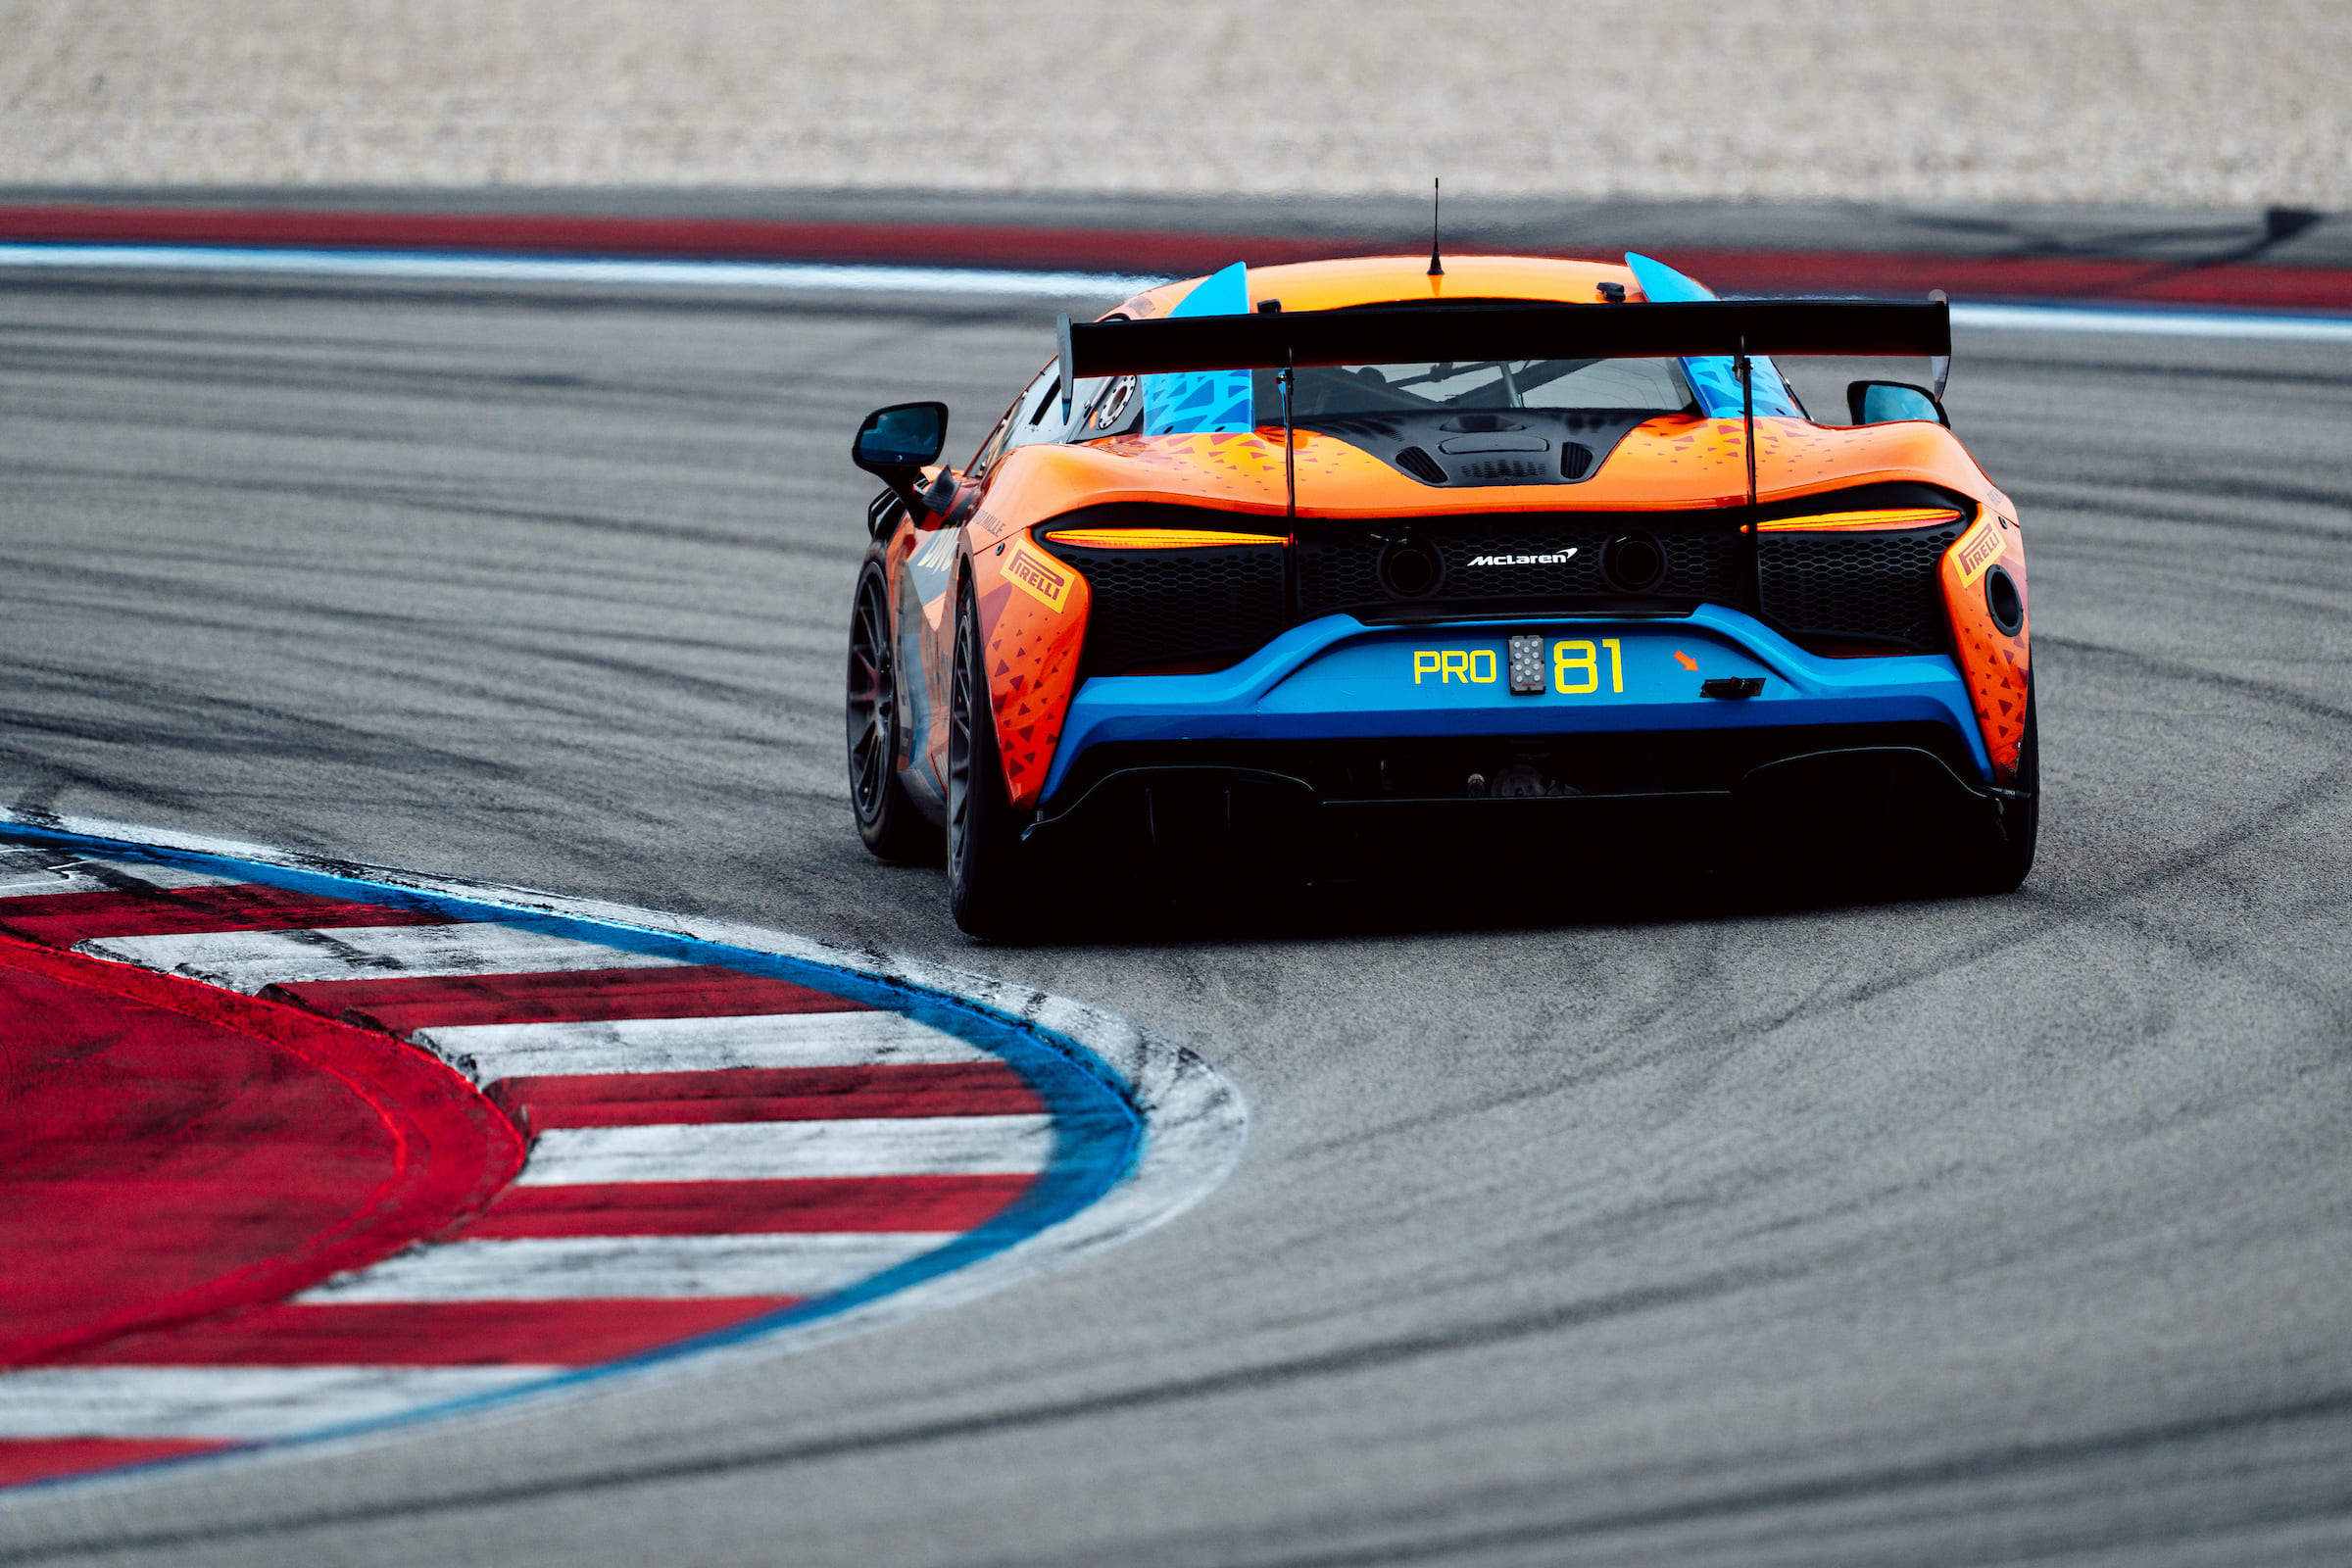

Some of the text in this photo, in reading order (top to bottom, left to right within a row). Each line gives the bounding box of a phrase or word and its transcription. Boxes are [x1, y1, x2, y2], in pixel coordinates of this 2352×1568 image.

[1008, 549, 1065, 601] PIRELLI
[1467, 554, 1567, 566] McLaren
[1958, 522, 2000, 576] PIRELLI
[1414, 638, 1624, 694] PRO 81
